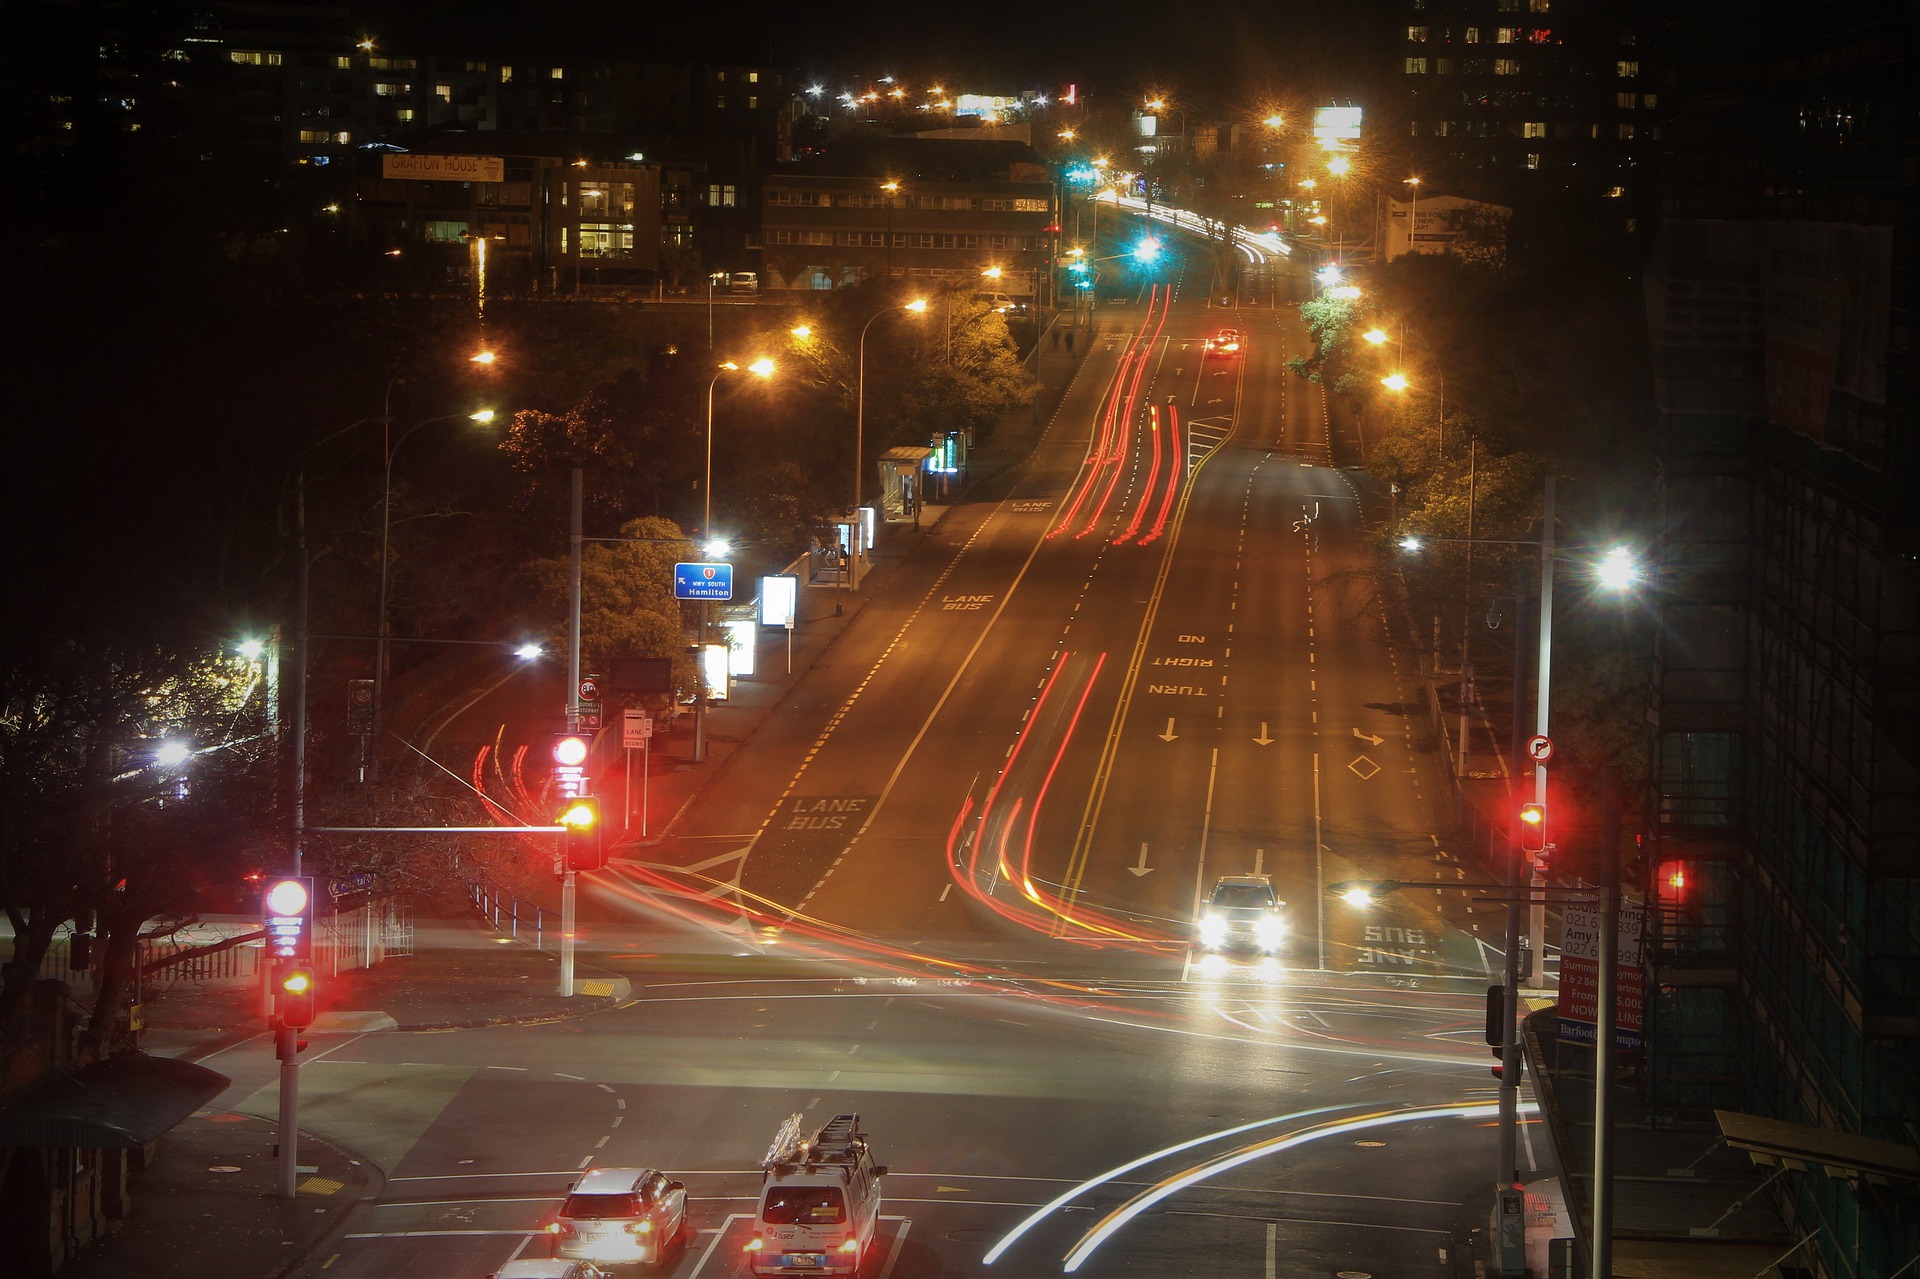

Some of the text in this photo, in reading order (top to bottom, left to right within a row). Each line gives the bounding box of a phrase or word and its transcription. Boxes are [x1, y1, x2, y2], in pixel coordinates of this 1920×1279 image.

[391, 156, 440, 171] GRAFTON
[444, 158, 478, 173] HOUSE
[689, 588, 729, 596] Hamilton
[942, 595, 994, 603] LANE
[1178, 634, 1206, 644] NO
[1151, 657, 1213, 667] RIGHT
[582, 684, 595, 694] 80
[1149, 684, 1208, 697] TURN
[792, 799, 867, 813] LANE
[786, 815, 848, 830] BUS
[1566, 914, 1587, 927] 021
[1364, 925, 1426, 945] BUS
[1566, 927, 1592, 944] Amy
[1565, 941, 1587, 955] 027
[1563, 959, 1598, 974] Summit
[1571, 988, 1597, 1001] From
[1571, 1003, 1598, 1017] NOW
